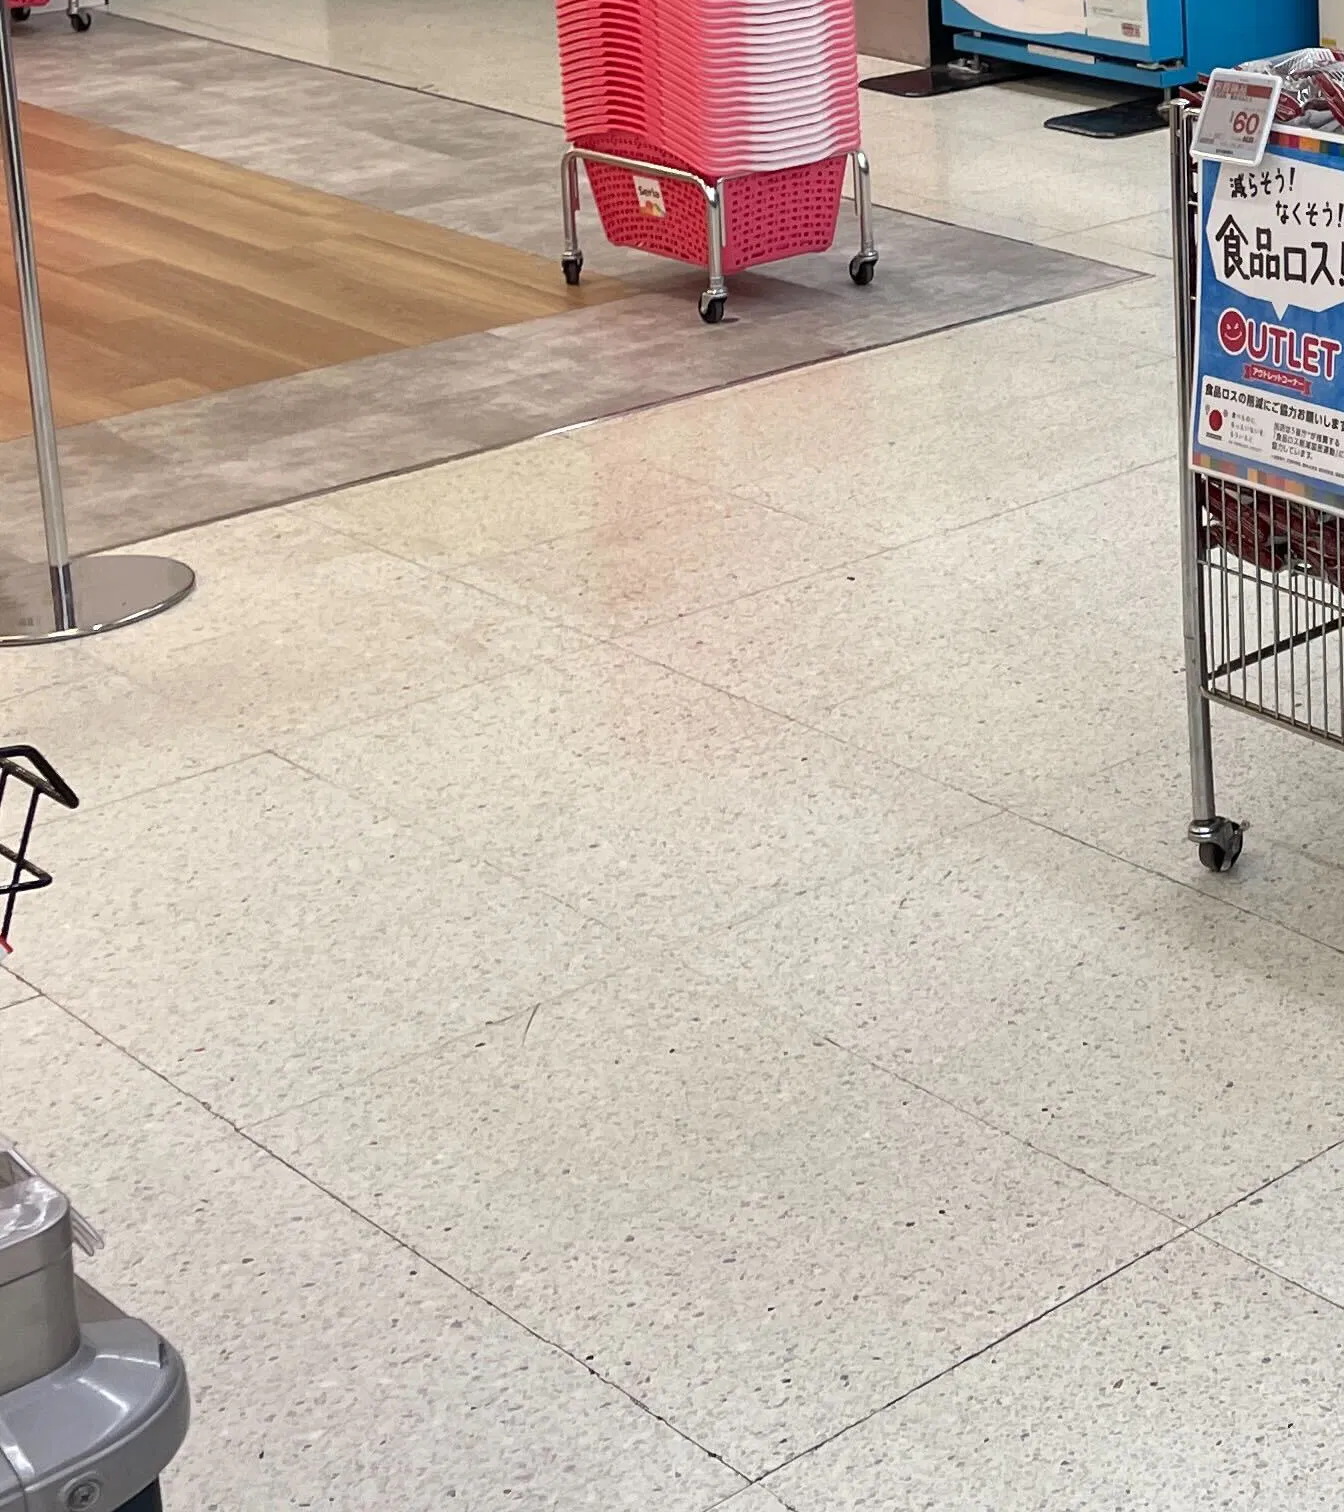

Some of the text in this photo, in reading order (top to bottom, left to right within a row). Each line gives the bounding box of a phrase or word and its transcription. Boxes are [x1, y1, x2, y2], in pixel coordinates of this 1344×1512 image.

[1233, 110, 1261, 136] 60
[1229, 167, 1297, 200] 減らそう!
[1275, 199, 1344, 229] なくそう!
[1219, 308, 1342, 381] OUTLET
